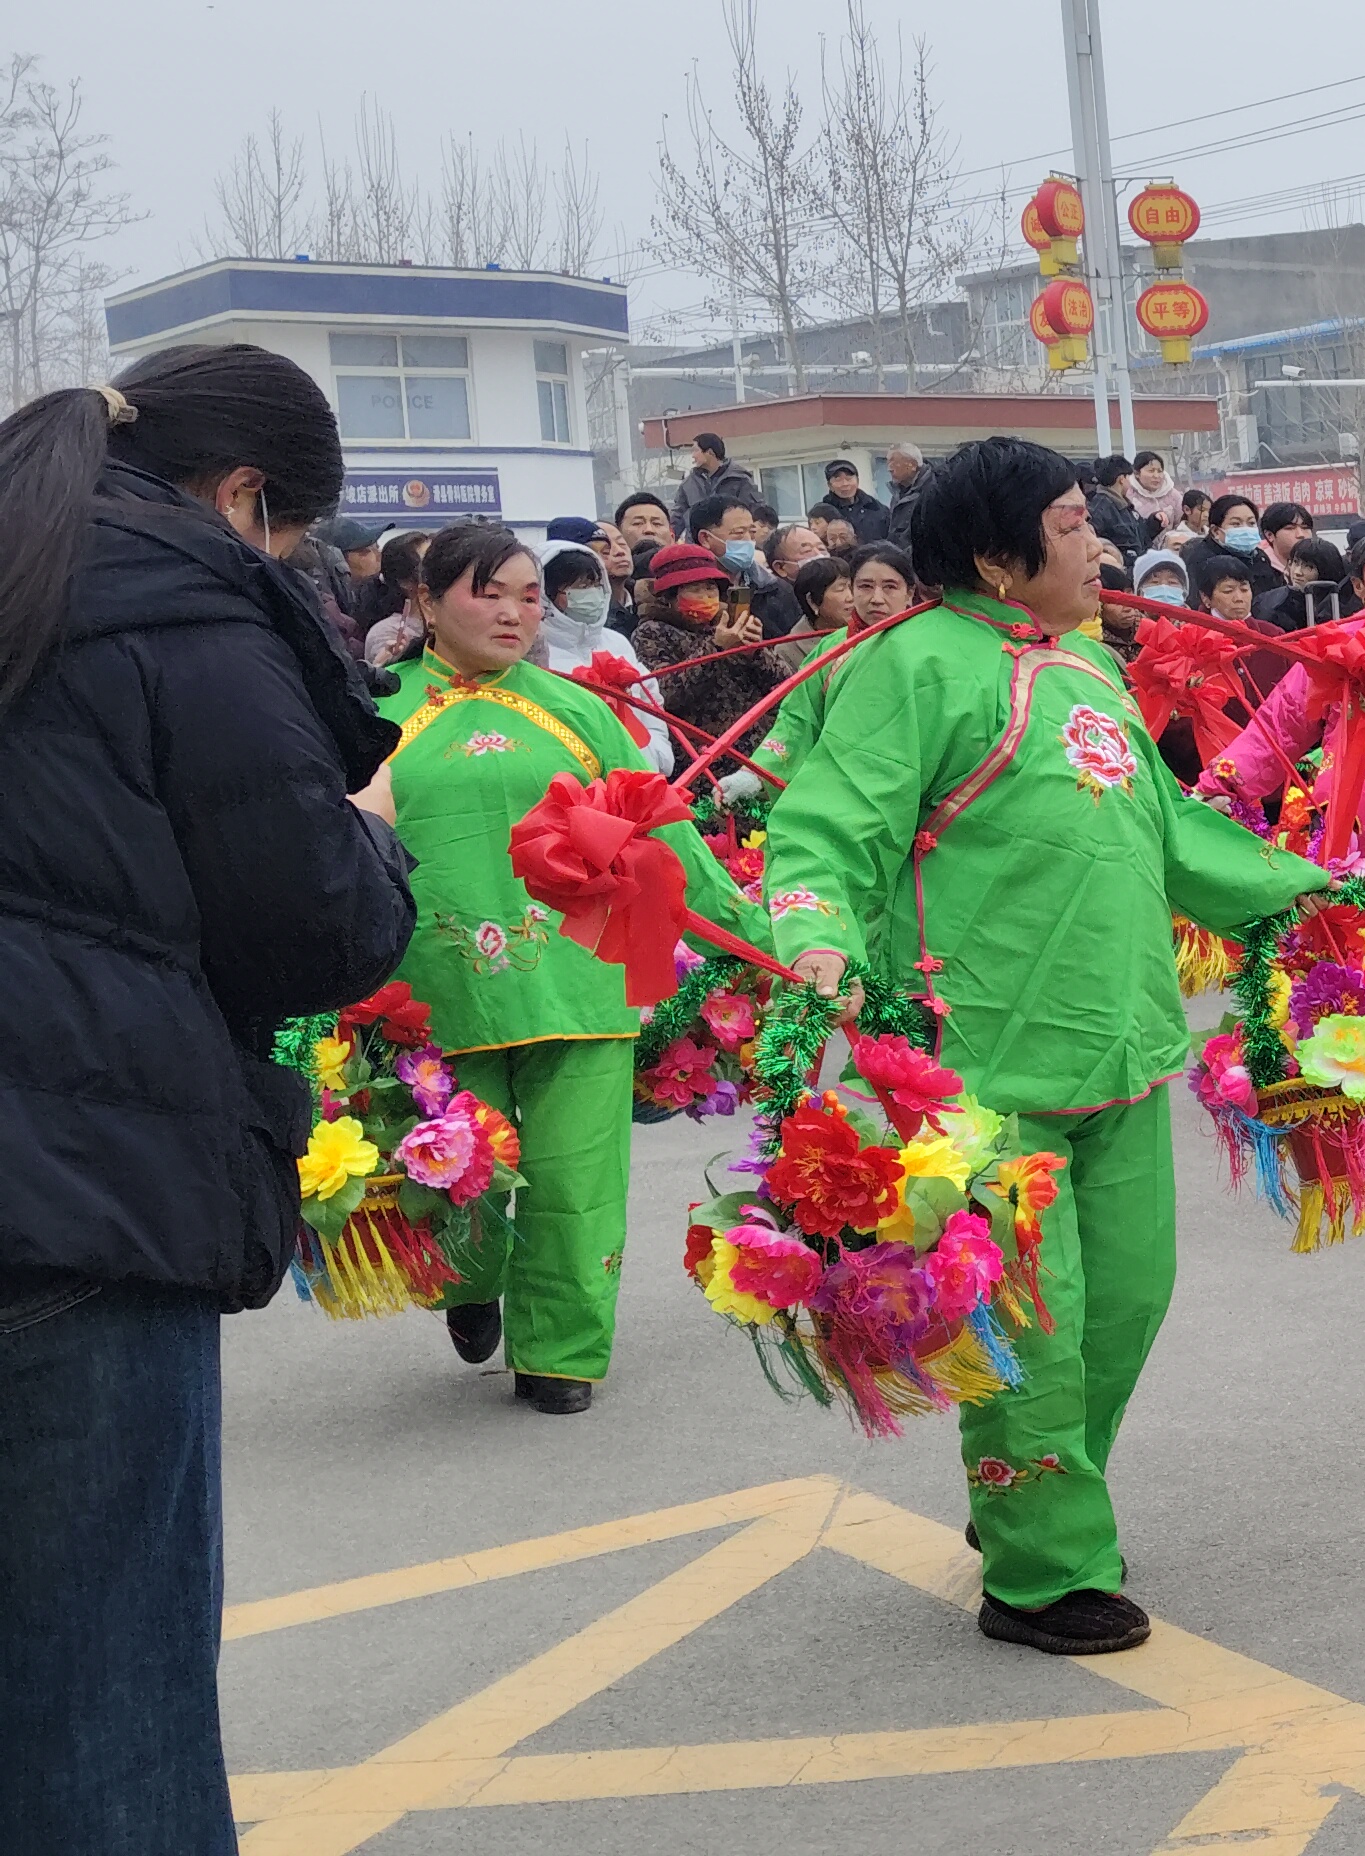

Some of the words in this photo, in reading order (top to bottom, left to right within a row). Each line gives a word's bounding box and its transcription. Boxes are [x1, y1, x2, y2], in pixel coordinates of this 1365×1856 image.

[1060, 201, 1080, 221] 公正
[1145, 206, 1181, 225] 自由
[1068, 298, 1088, 319] 法治
[1152, 301, 1191, 320] 平等
[371, 395, 434, 409] POLICE
[340, 484, 399, 504] 坡店派出所
